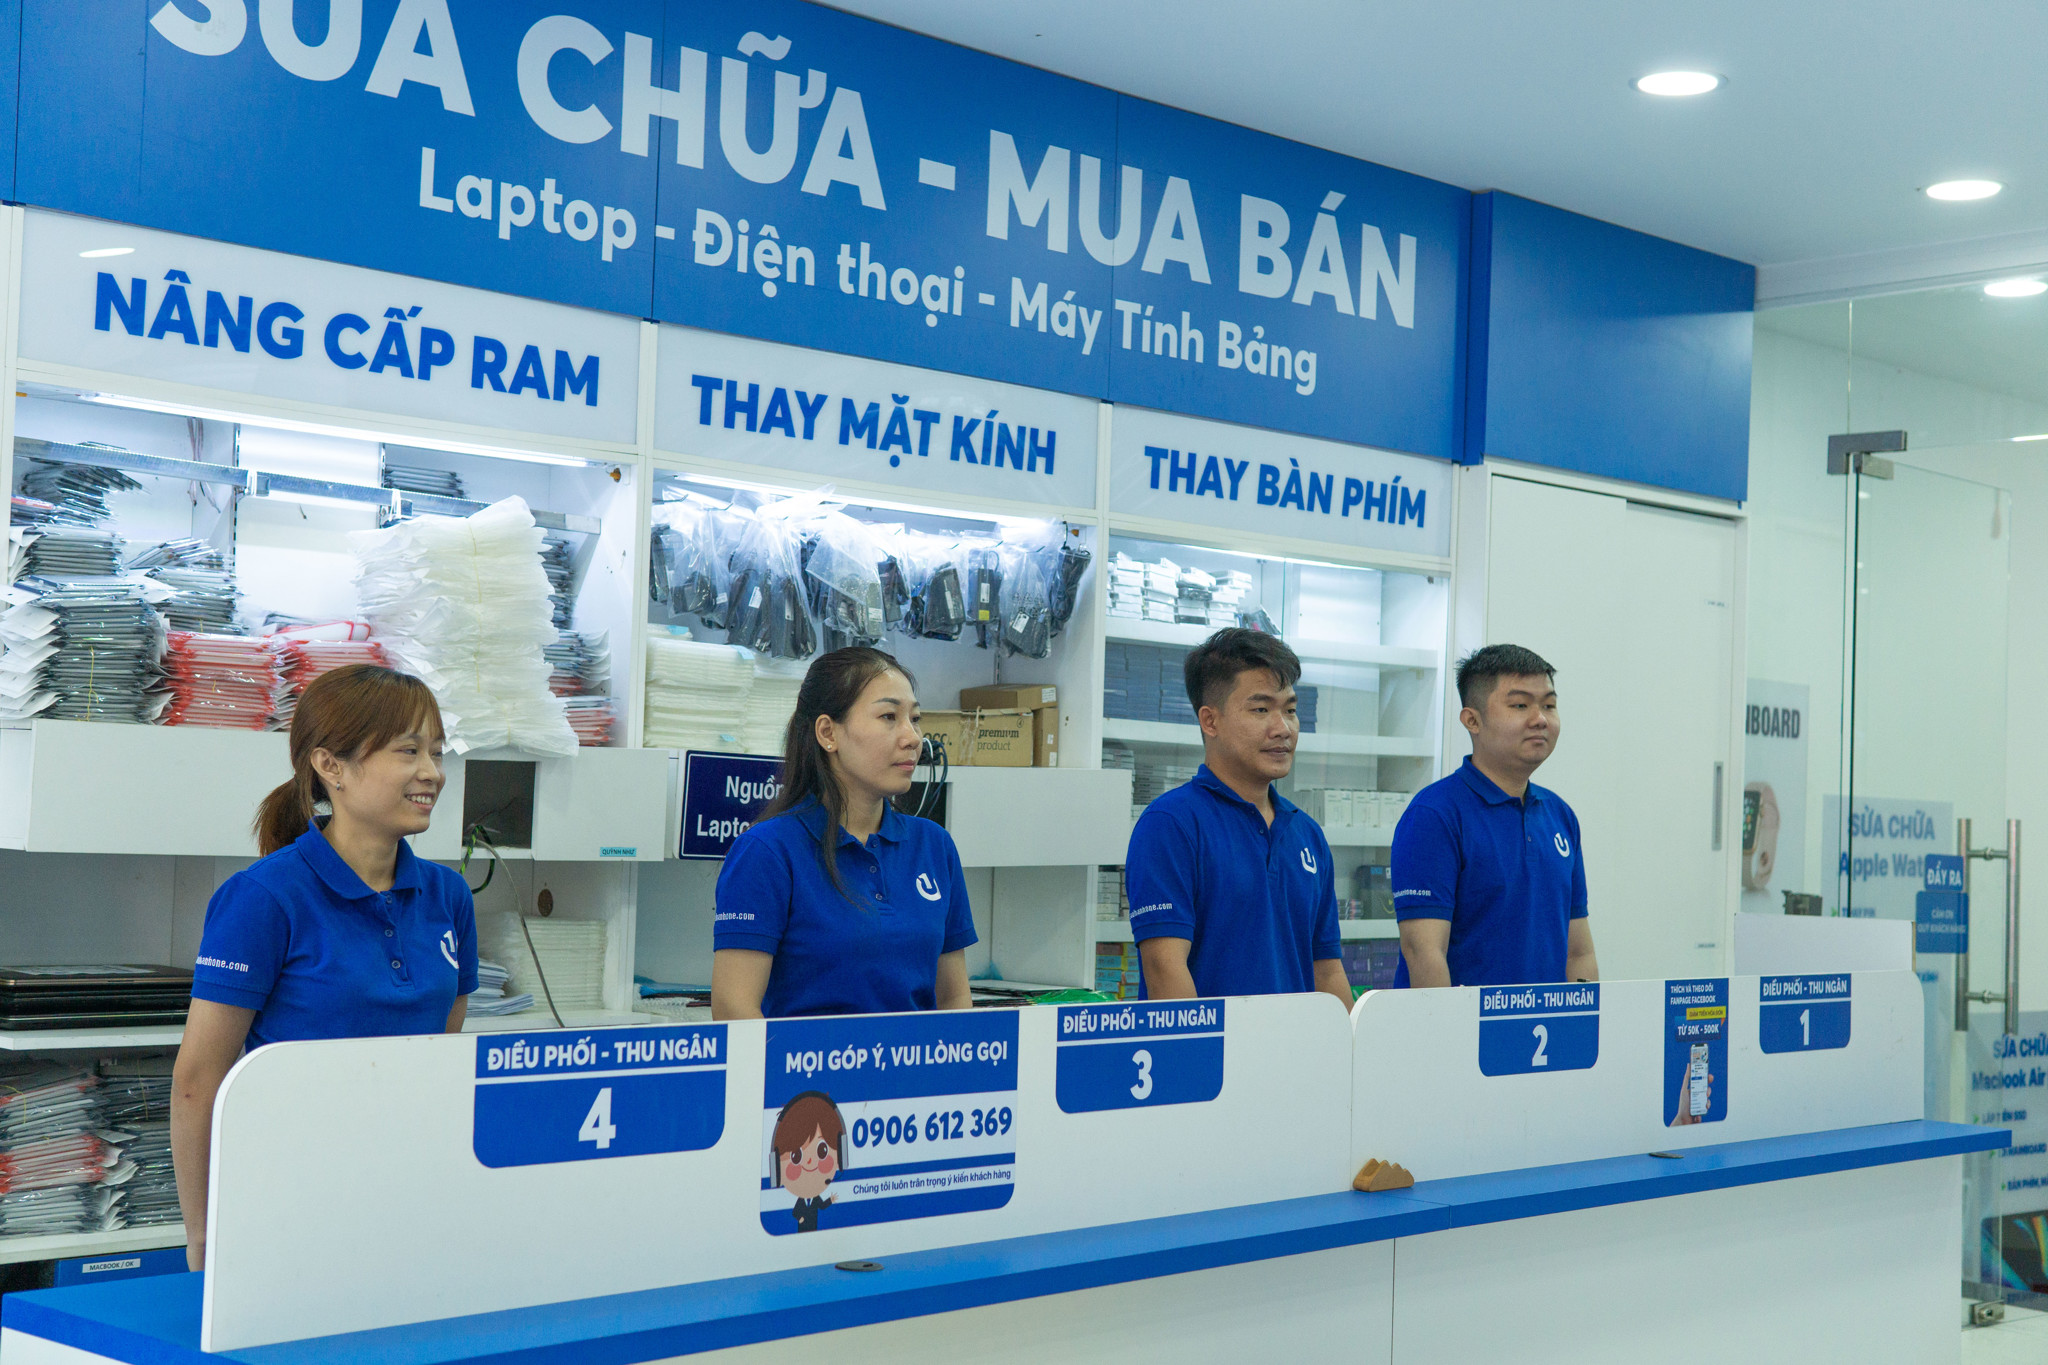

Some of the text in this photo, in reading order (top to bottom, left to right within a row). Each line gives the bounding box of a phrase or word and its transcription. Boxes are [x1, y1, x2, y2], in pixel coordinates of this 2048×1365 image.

[516, 15, 887, 212] CHỮA
[919, 158, 956, 191] -
[986, 129, 1212, 285] MUA
[1238, 189, 1418, 329] BÁN
[419, 147, 1318, 395] Laptop - Điện thoại - Máy Tính Bảng
[94, 269, 600, 407] NÂNG CẤP RAM
[691, 374, 1057, 475] THAY MẶT KÍNH
[1144, 445, 1427, 528] THAY BÀN PHÍM
[977, 740, 1011, 752] product
[697, 814, 751, 843] Lapto
[1848, 805, 1936, 841] SỬA CHỮA
[1840, 851, 1925, 881] Apple Wat
[1949, 872, 1963, 886] RA
[1484, 989, 1508, 1010] ĐIỀU
[1510, 988, 1536, 1009] PHỐI
[1544, 991, 1564, 1008] THU
[1565, 988, 1595, 1007] NGÂN
[1763, 978, 1782, 997] ĐIỀU
[1783, 977, 1803, 995] PHỐI
[1808, 981, 1824, 994] THU
[1825, 977, 1847, 994] NGÂN
[1063, 1009, 1098, 1034] ĐIỀU
[1101, 1006, 1136, 1032] PHỐI
[1147, 1009, 1175, 1029] THU
[1177, 1004, 1217, 1027] NGÂN
[1687, 1025, 1700, 1035] 50K
[1704, 1024, 1719, 1034] 500K
[1799, 1009, 1810, 1046] 1
[487, 1039, 539, 1071] ĐIỀU
[544, 1036, 597, 1067] PHỐI
[614, 1040, 655, 1063] THU
[659, 1033, 717, 1061] NGÂN
[785, 1039, 1008, 1078] MỌI GÓP Ý, VUI LÒNG GỌI
[1531, 1024, 1549, 1067] 2
[2020, 1032, 2048, 1057] CHỮ
[1129, 1049, 1153, 1100] 3
[2029, 1067, 2046, 1087] Air
[578, 1087, 617, 1149] 4
[852, 1106, 1012, 1149] 0906 612 369
[853, 1182, 879, 1195] Chúng
[880, 1181, 891, 1191] tôi
[909, 1178, 925, 1188] trân
[926, 1178, 946, 1188] trọng
[953, 1171, 969, 1184] kiến
[969, 1170, 992, 1182] khách
[993, 1169, 1012, 1180] hàng
[90, 1262, 120, 1271] MACBOOK
